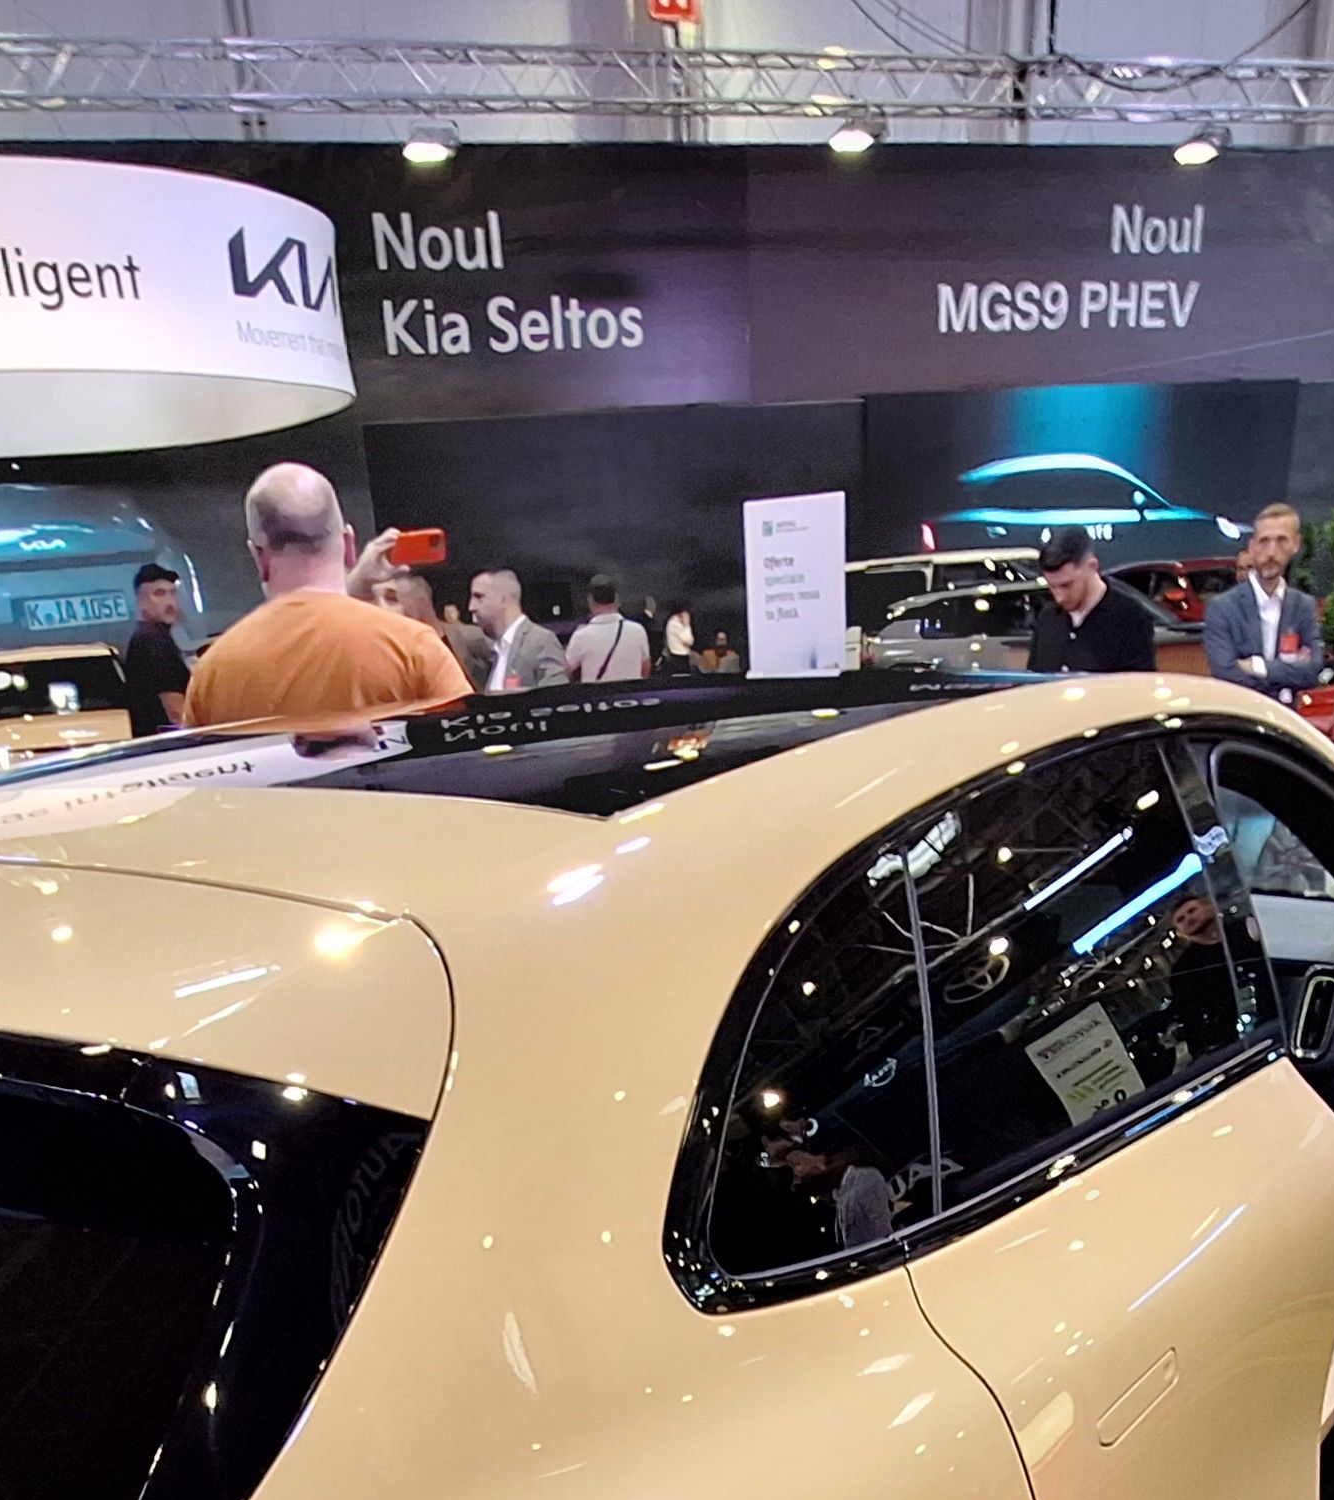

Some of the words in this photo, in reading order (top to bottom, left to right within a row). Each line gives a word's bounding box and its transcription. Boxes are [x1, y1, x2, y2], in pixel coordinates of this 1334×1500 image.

[371, 210, 504, 271] Noul
[1110, 203, 1205, 254] Noul
[382, 298, 471, 356] Kia
[486, 294, 644, 353] Seltos
[936, 280, 1068, 333] MGS9
[1078, 279, 1200, 329] PHEV
